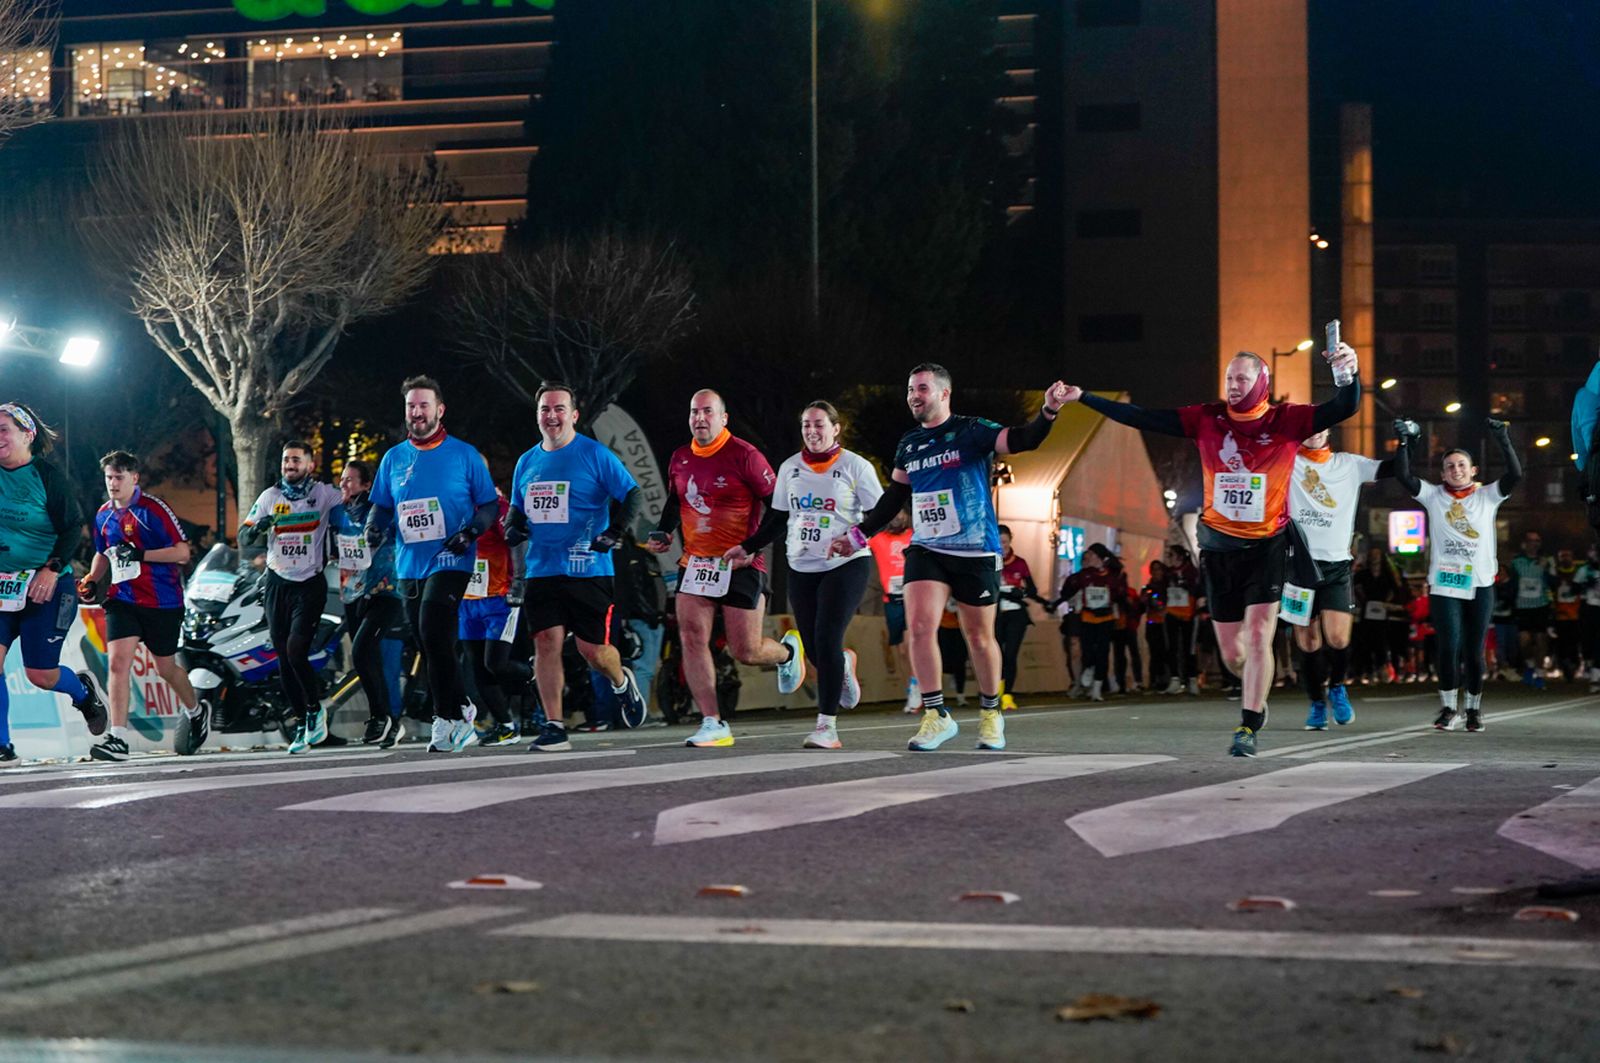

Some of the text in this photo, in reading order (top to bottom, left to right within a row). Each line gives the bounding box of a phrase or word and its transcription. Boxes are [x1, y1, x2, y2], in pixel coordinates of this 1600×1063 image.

[624, 428, 663, 517] PEMASA
[533, 496, 559, 510] 5729
[1223, 490, 1253, 505] 7612
[406, 512, 434, 529] 4651
[918, 507, 947, 523] 1459
[281, 545, 307, 556] 6244
[694, 568, 720, 583] 7614
